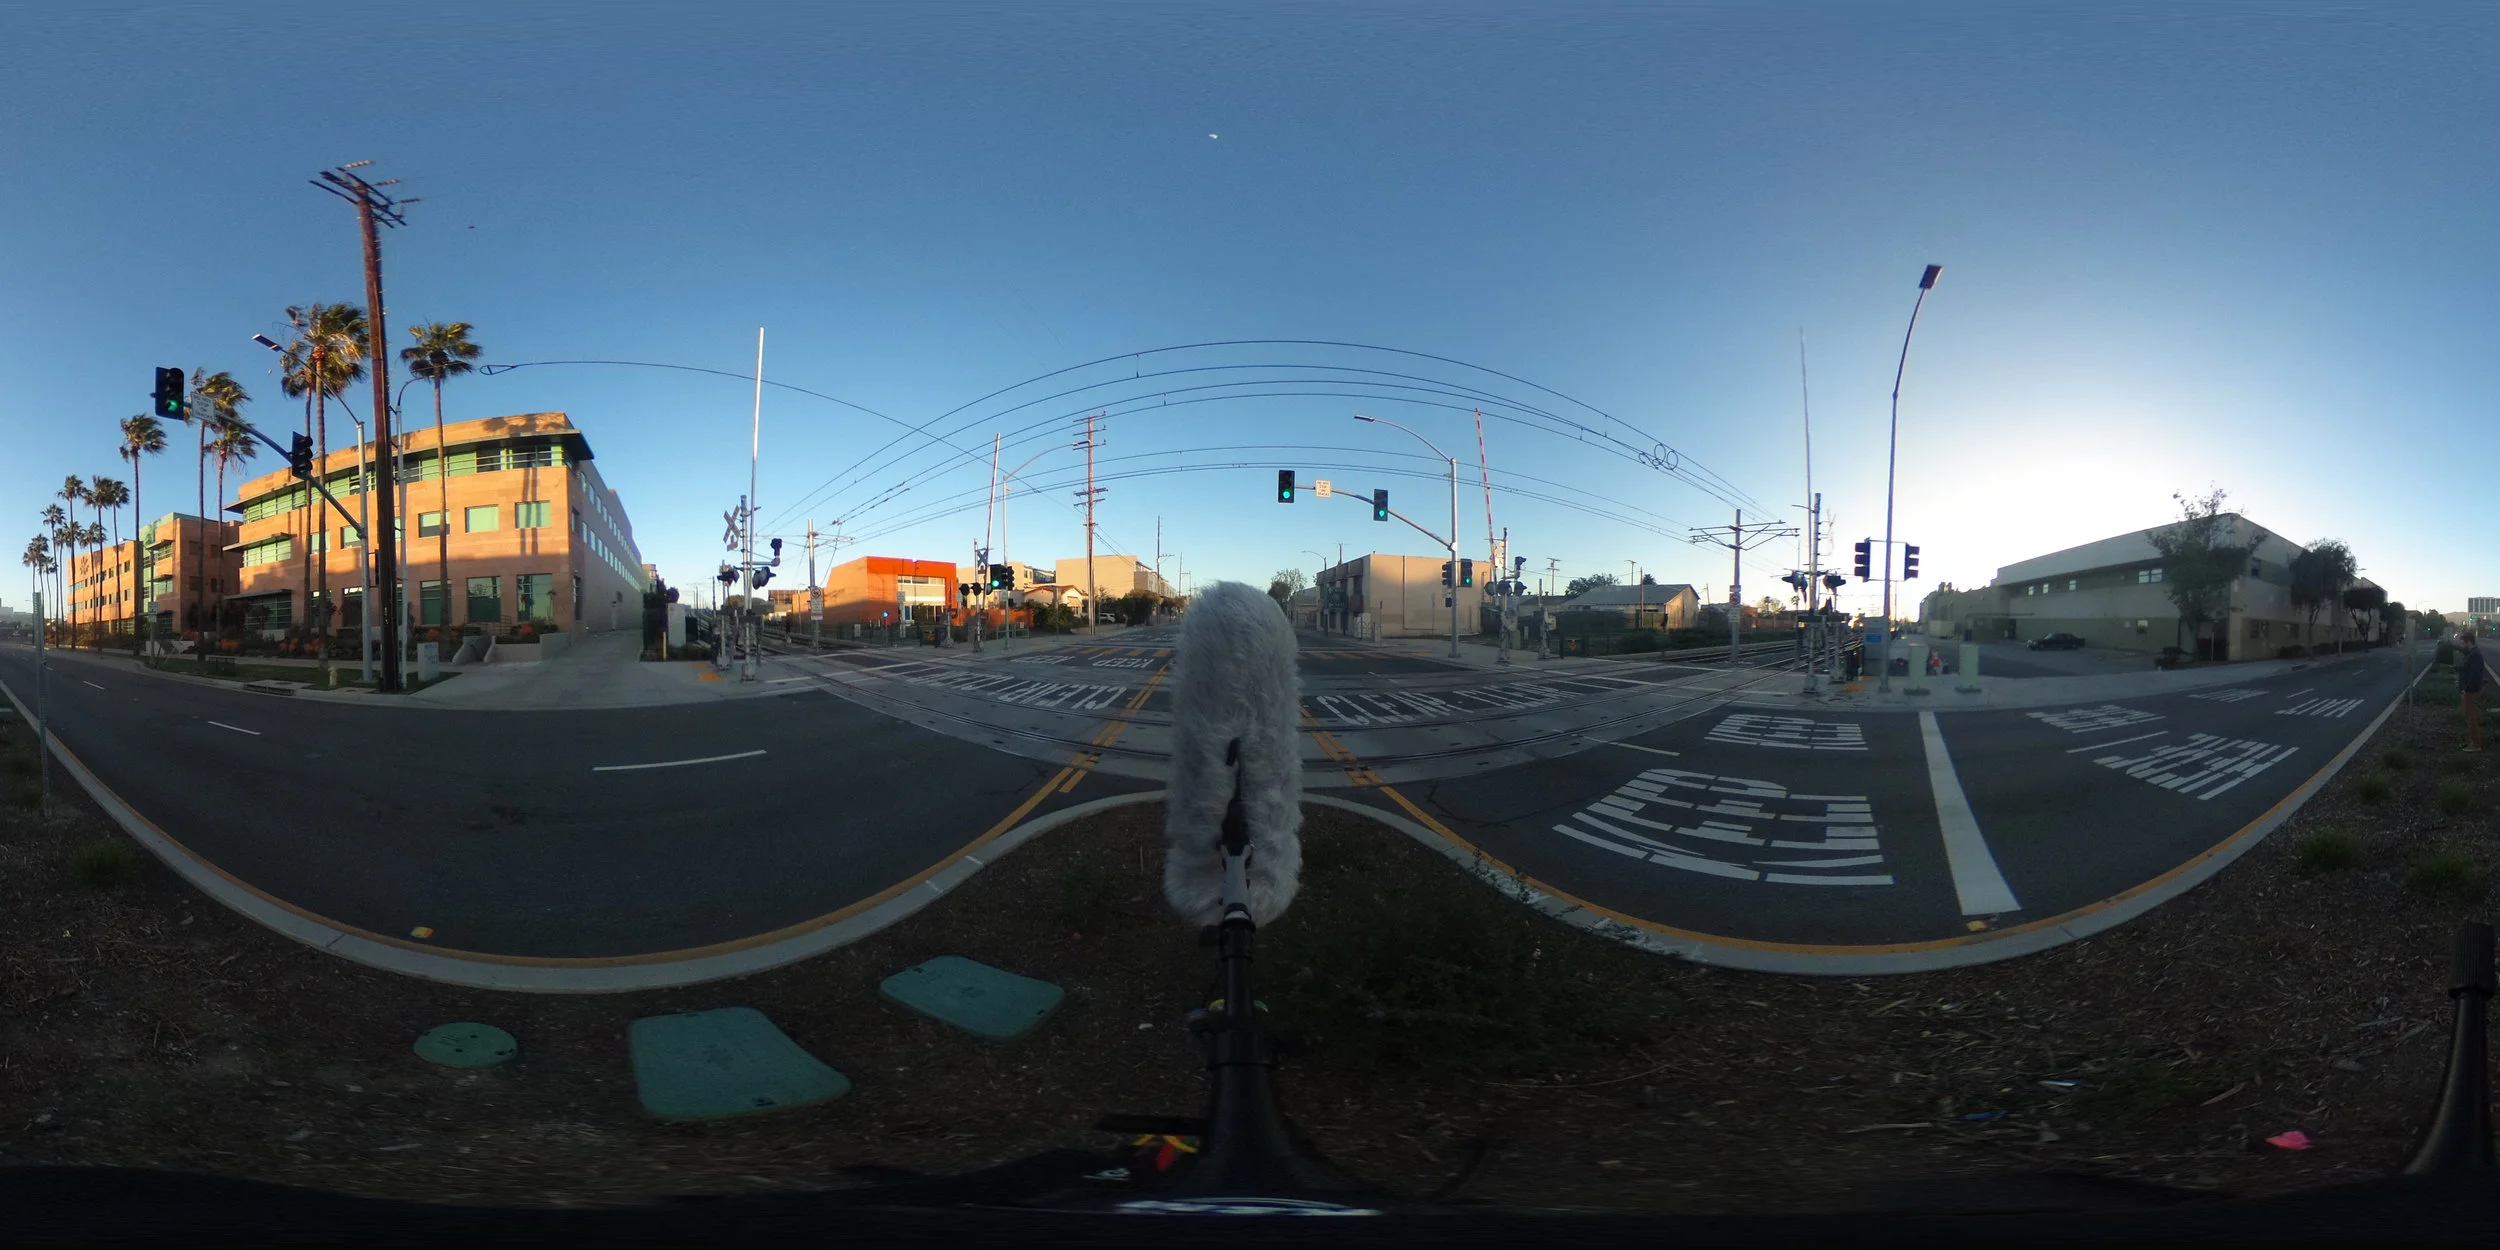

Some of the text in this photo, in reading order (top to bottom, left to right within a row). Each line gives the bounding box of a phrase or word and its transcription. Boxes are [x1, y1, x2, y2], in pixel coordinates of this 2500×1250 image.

[1092, 657, 1155, 668] KEEP
[997, 681, 1128, 710] CLEAR
[1316, 691, 1474, 725] CLEAR
[2275, 698, 2365, 718] WAIT
[1703, 714, 1868, 750] KEEP
[2093, 733, 2300, 800] HERE
[1552, 768, 1895, 885] KEEP
